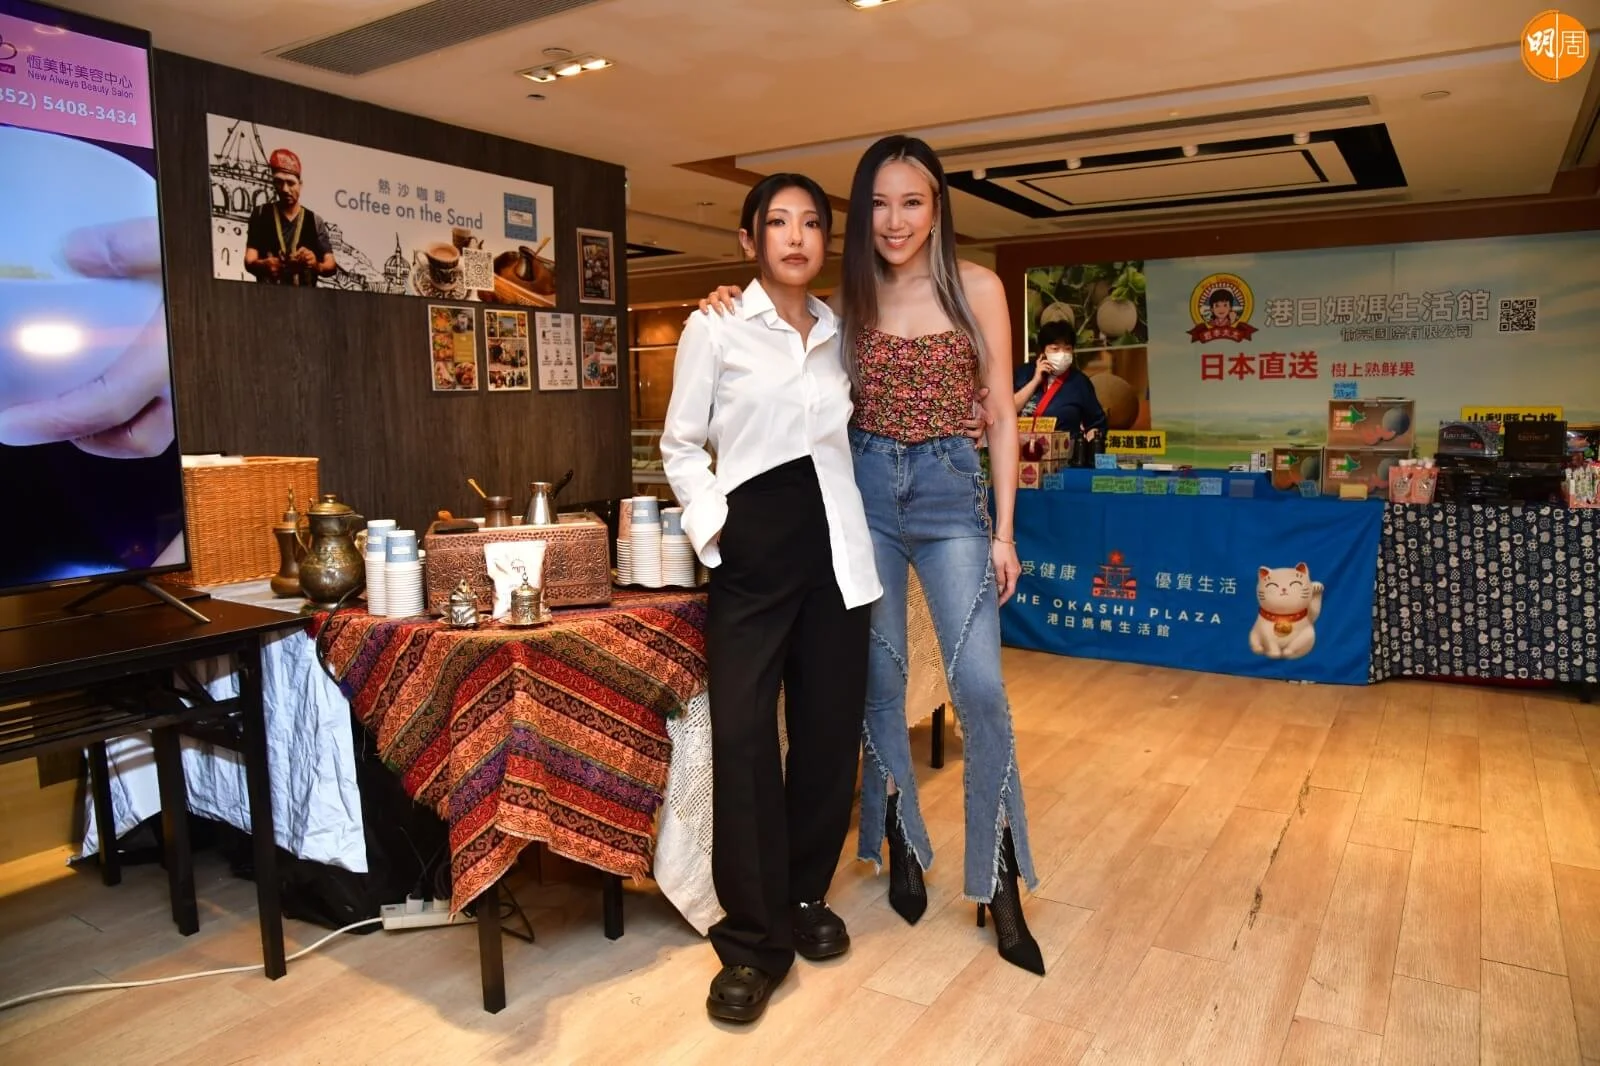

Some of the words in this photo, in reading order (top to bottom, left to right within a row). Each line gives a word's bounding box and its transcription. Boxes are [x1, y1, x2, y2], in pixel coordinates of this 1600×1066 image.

[27, 69, 47, 81] New
[49, 74, 79, 89] Always
[81, 81, 109, 96] Beauty
[112, 87, 134, 99] Salon
[43, 95, 137, 126] 5408-3434
[378, 178, 446, 204] 熱沙咖啡
[334, 188, 391, 216] Coffee
[395, 205, 416, 220] on
[420, 203, 443, 224] the
[447, 208, 483, 230] Sand
[1264, 288, 1491, 328] 港日媽媽生活館
[1201, 350, 1318, 381] 日本直送
[1330, 360, 1416, 378] 樹上熟鮮果
[1104, 434, 1162, 449] 海道蜜瓜
[1021, 560, 1077, 581] 受健康
[1155, 571, 1238, 595] 優質生活
[1016, 592, 1041, 606] HE
[1053, 599, 1135, 617] OKASHI
[1150, 607, 1222, 625] PLAZA
[1047, 612, 1171, 638] 港日媽媽生活館
